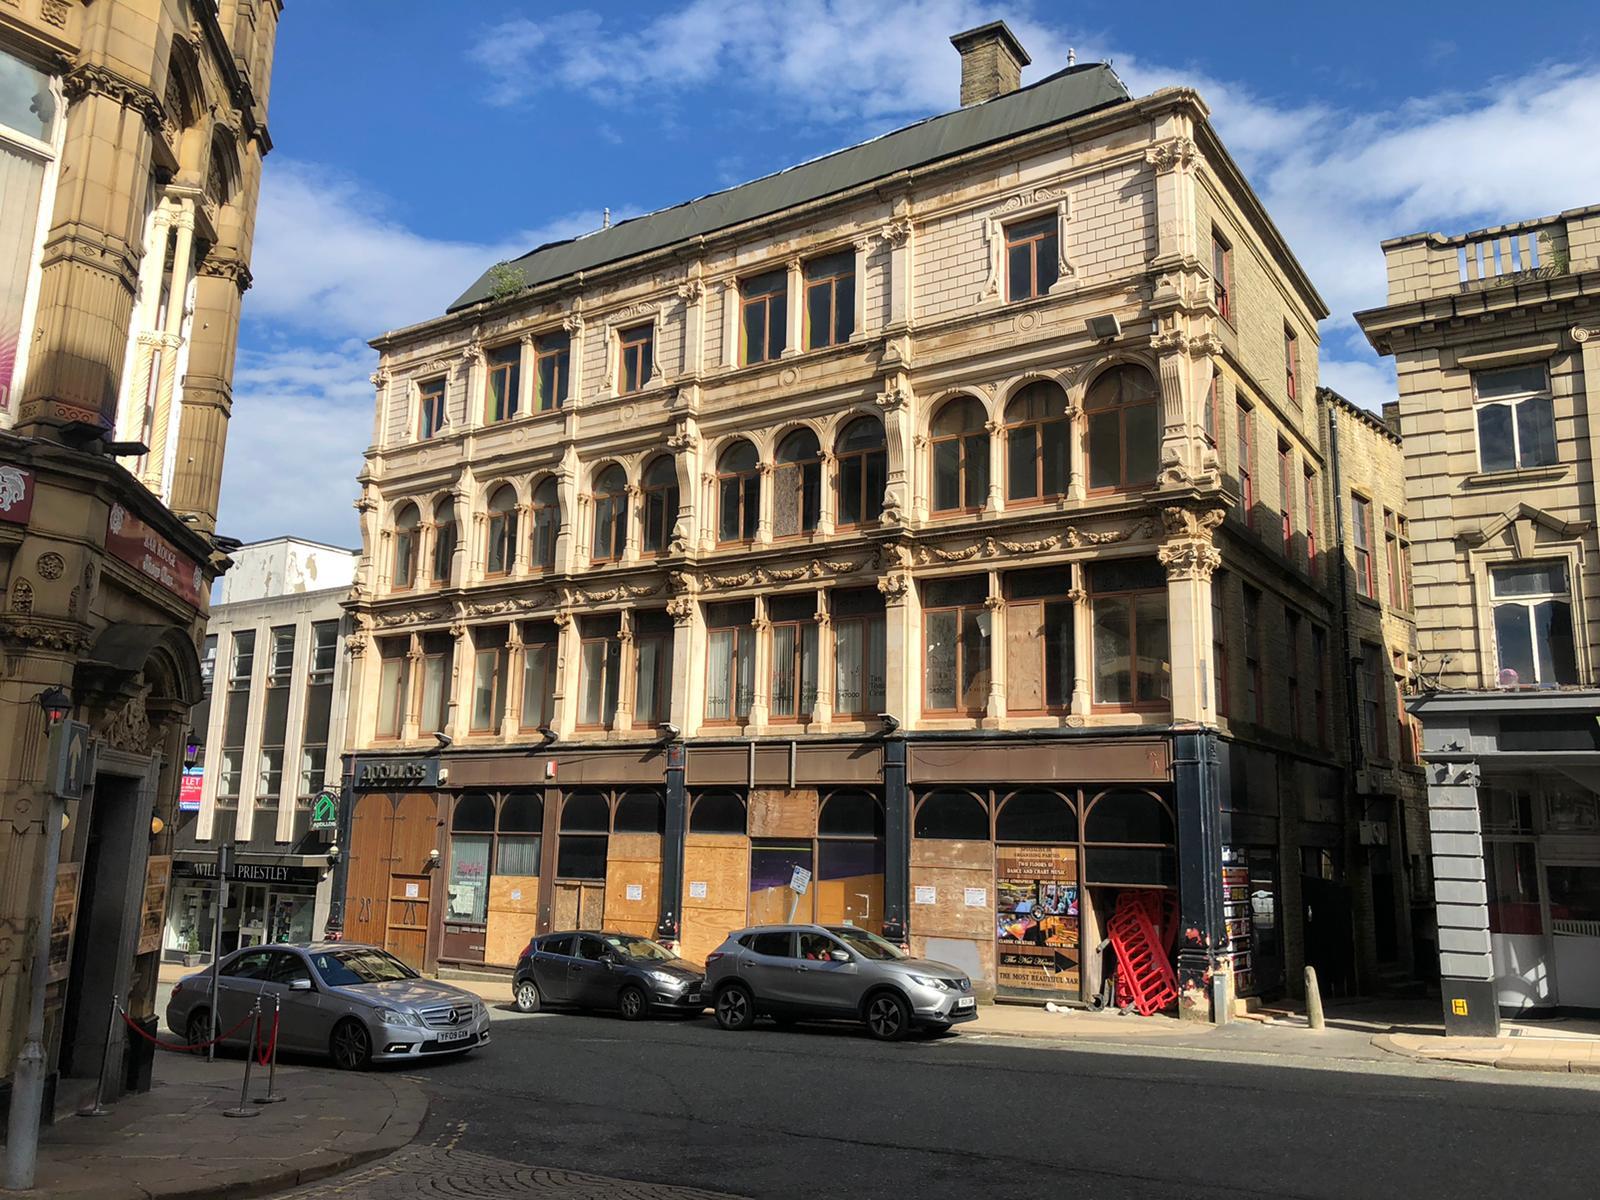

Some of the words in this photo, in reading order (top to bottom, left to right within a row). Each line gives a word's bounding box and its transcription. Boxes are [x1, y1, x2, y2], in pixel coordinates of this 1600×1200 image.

[238, 864, 289, 881] PRIESTLEY
[1003, 955, 1017, 963] The
[1012, 973, 1029, 981] MOST
[1031, 975, 1063, 983] BEAUTIFUL
[1065, 977, 1079, 985] BAR
[1454, 1000, 1466, 1014] H
[440, 1031, 458, 1041] YF09
